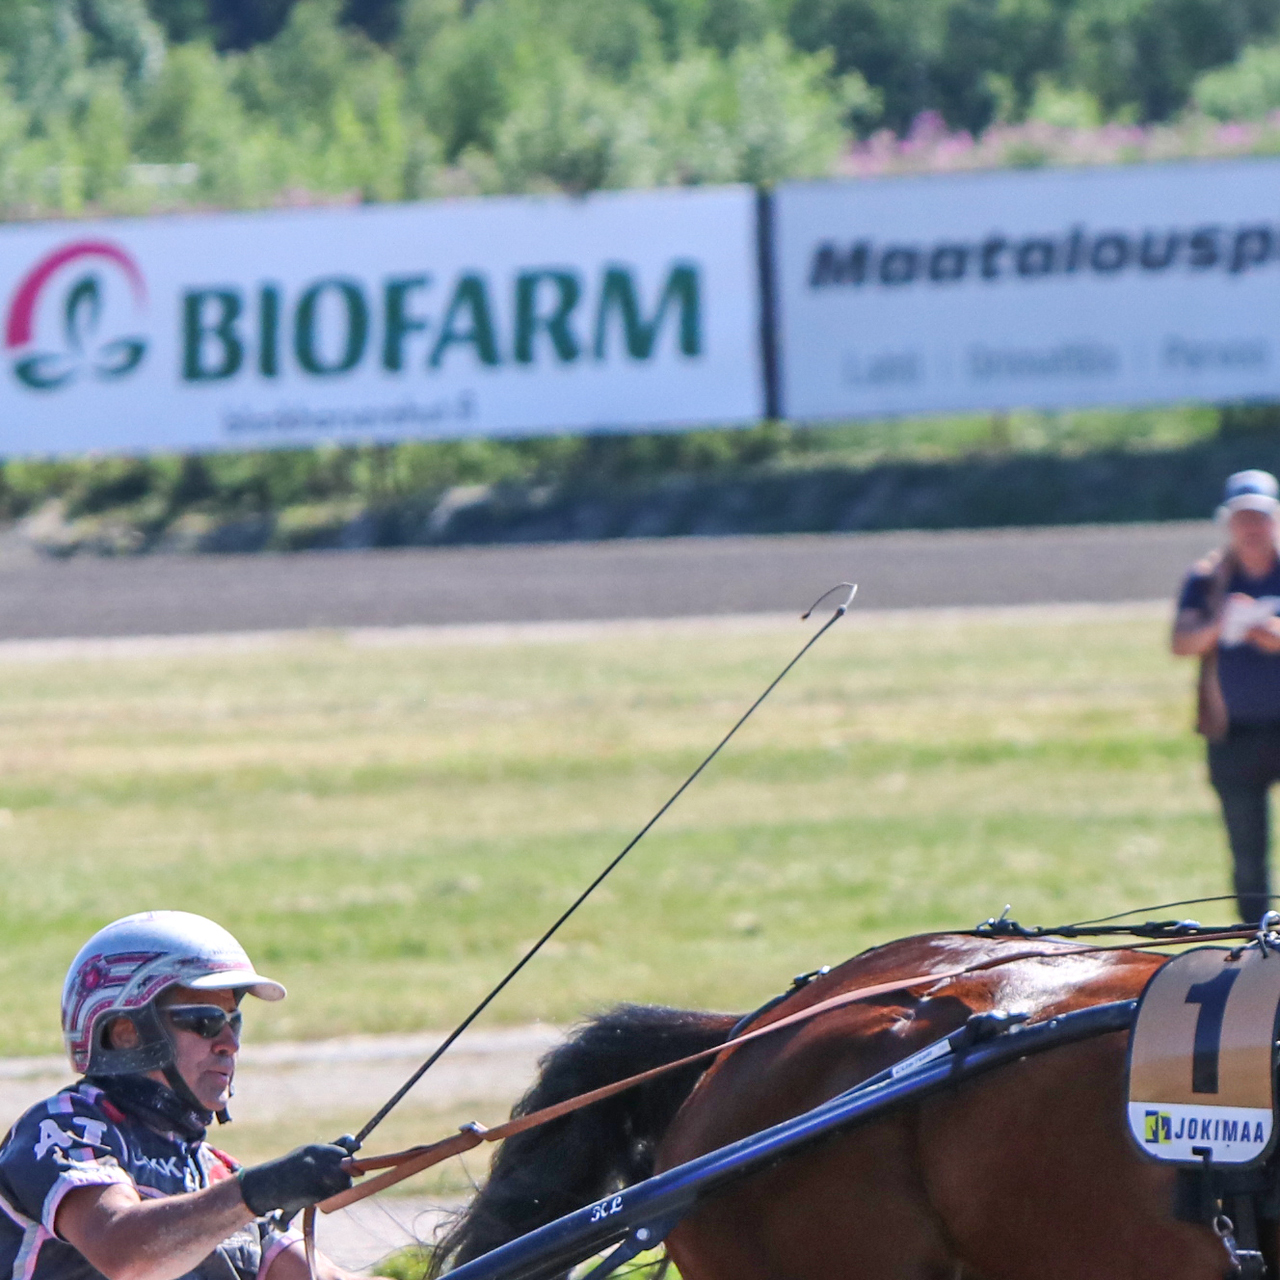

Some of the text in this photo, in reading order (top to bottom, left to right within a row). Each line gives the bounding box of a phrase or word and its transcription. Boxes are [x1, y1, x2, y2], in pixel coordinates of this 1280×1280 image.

[179, 257, 704, 383] BIOFARM
[1184, 968, 1242, 1094] 1
[1175, 1117, 1265, 1143] JOKIMAA
